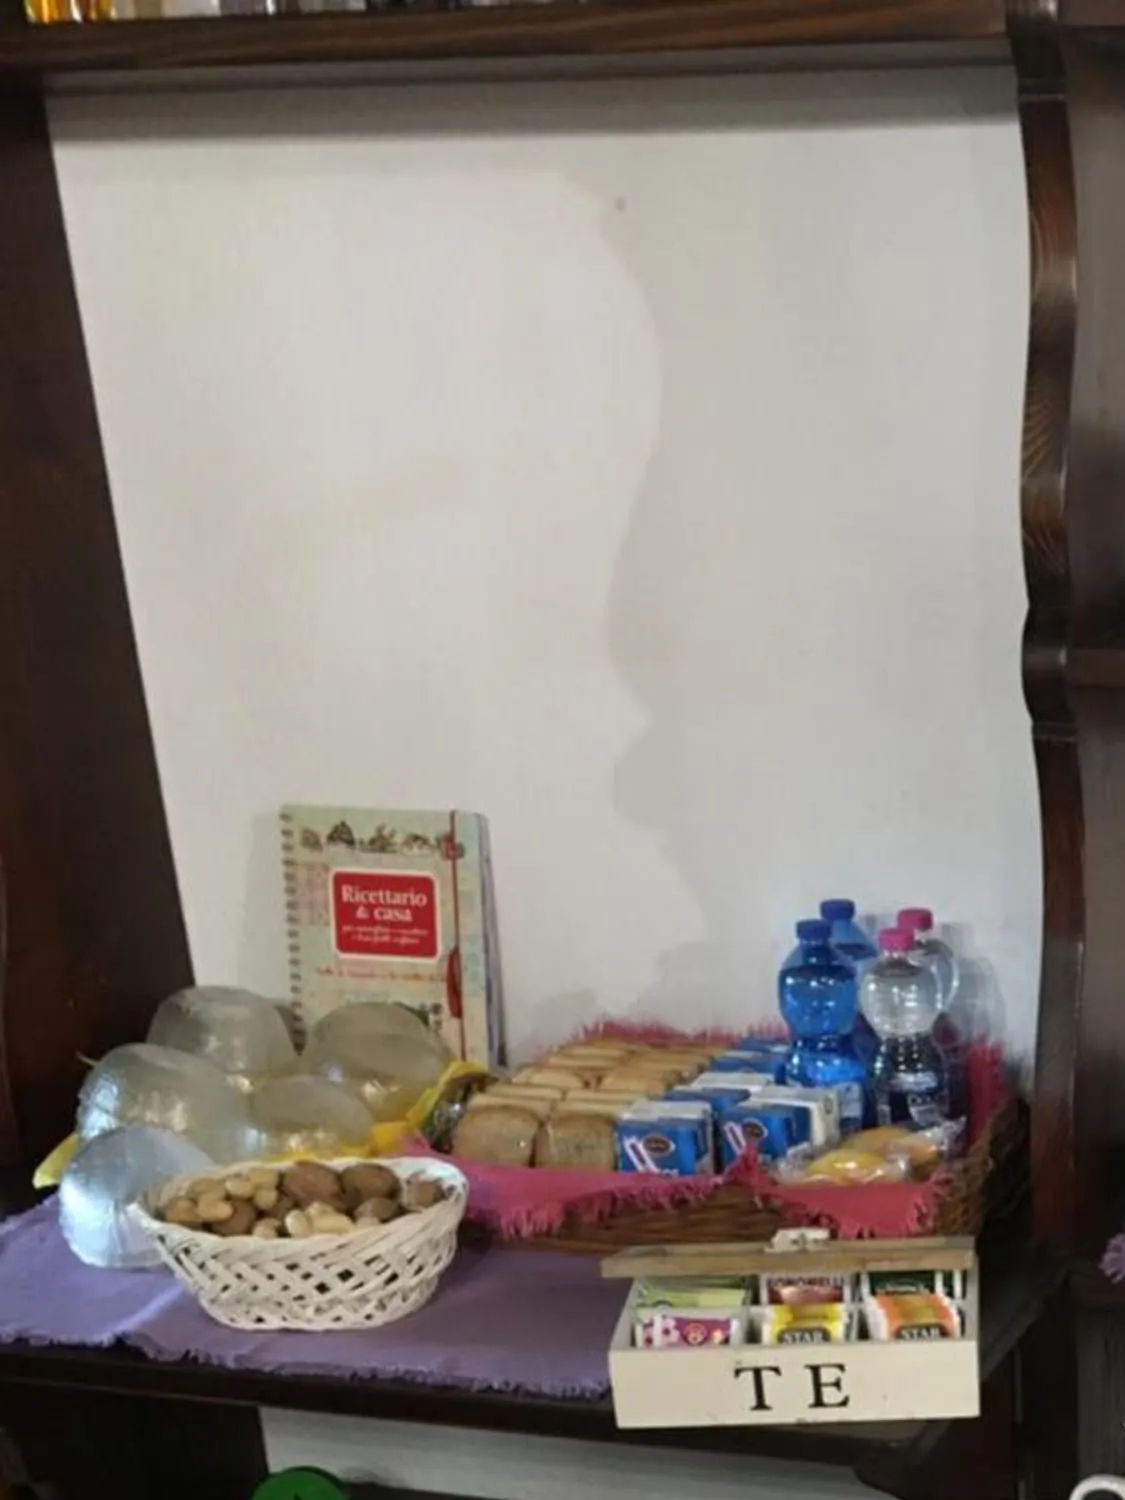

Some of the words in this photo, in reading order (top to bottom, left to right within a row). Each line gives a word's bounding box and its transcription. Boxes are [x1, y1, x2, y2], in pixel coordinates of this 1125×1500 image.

[341, 884, 428, 907] Ricettario
[783, 1330, 824, 1344] STAR
[901, 1327, 941, 1340] STAR
